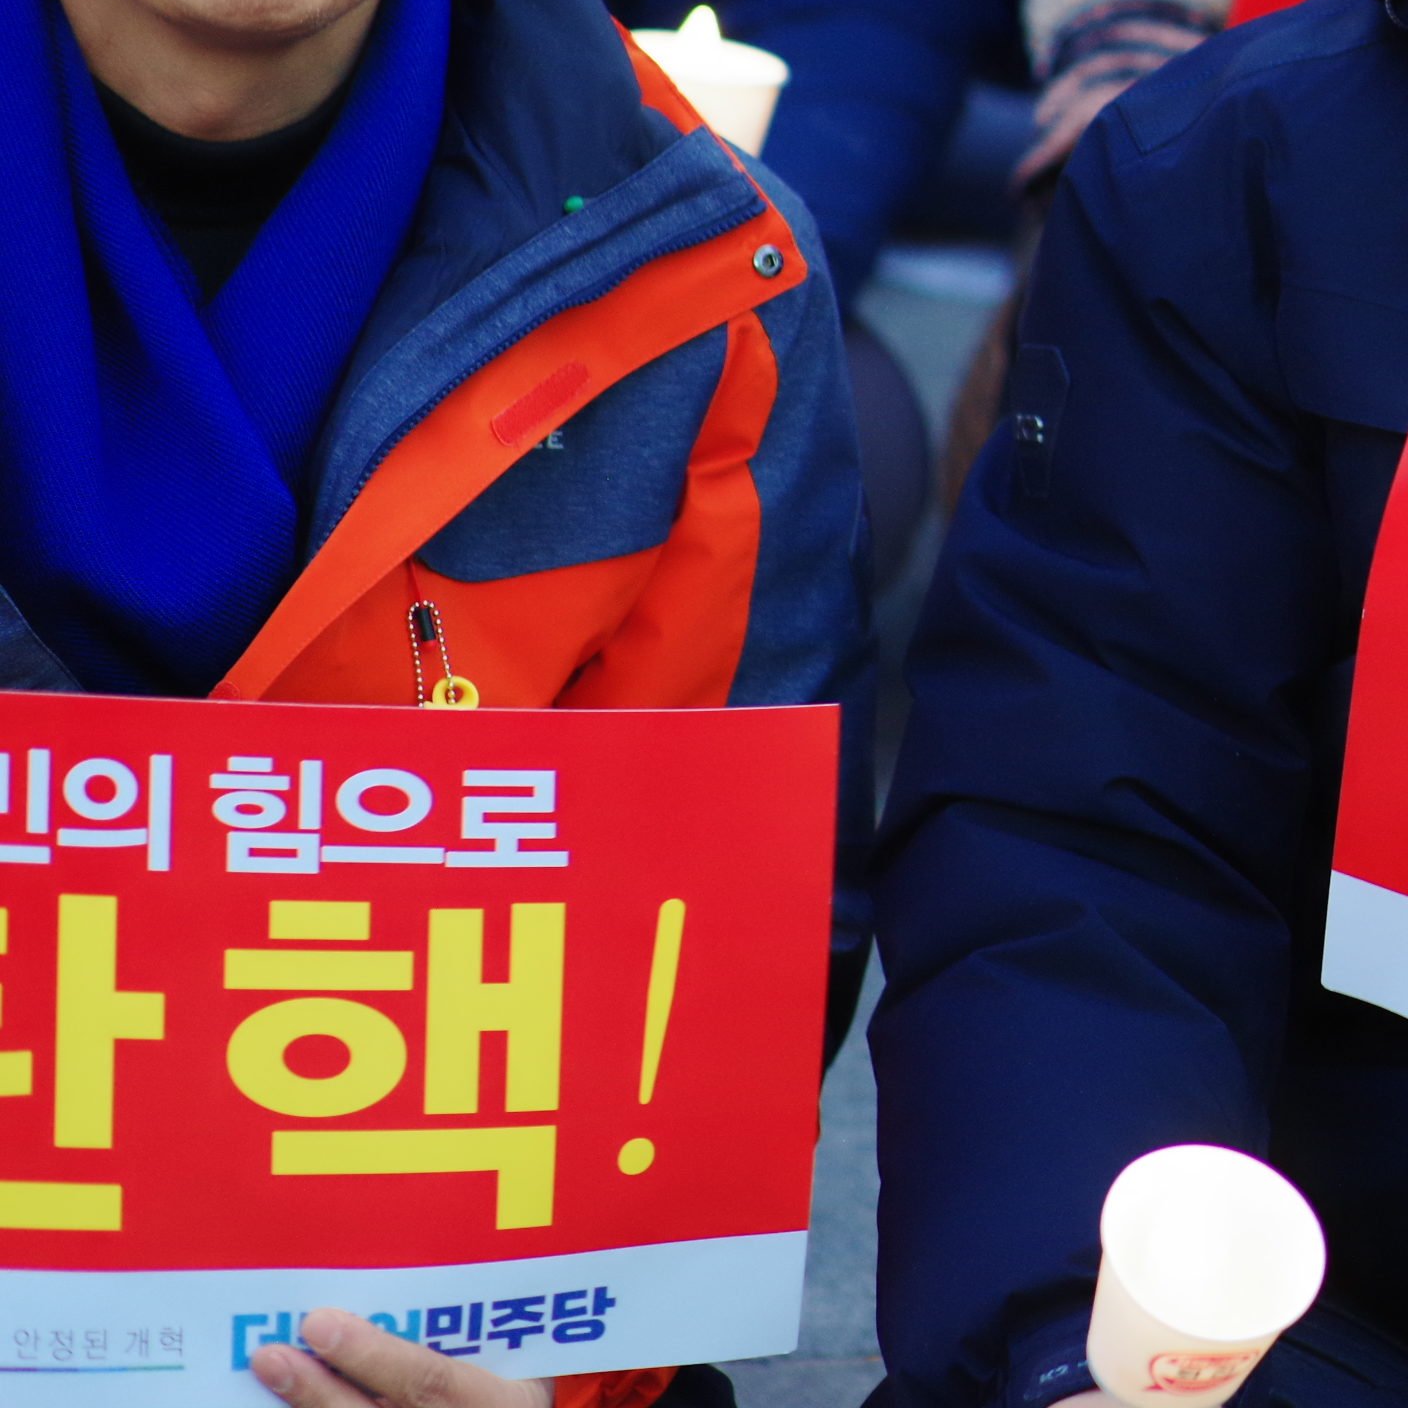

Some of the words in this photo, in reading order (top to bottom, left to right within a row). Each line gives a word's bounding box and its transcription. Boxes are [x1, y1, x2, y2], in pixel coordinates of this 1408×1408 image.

[209, 756, 569, 875] 힘으로
[12, 1327, 109, 1362] 안정된
[124, 1325, 184, 1359] 개혁
